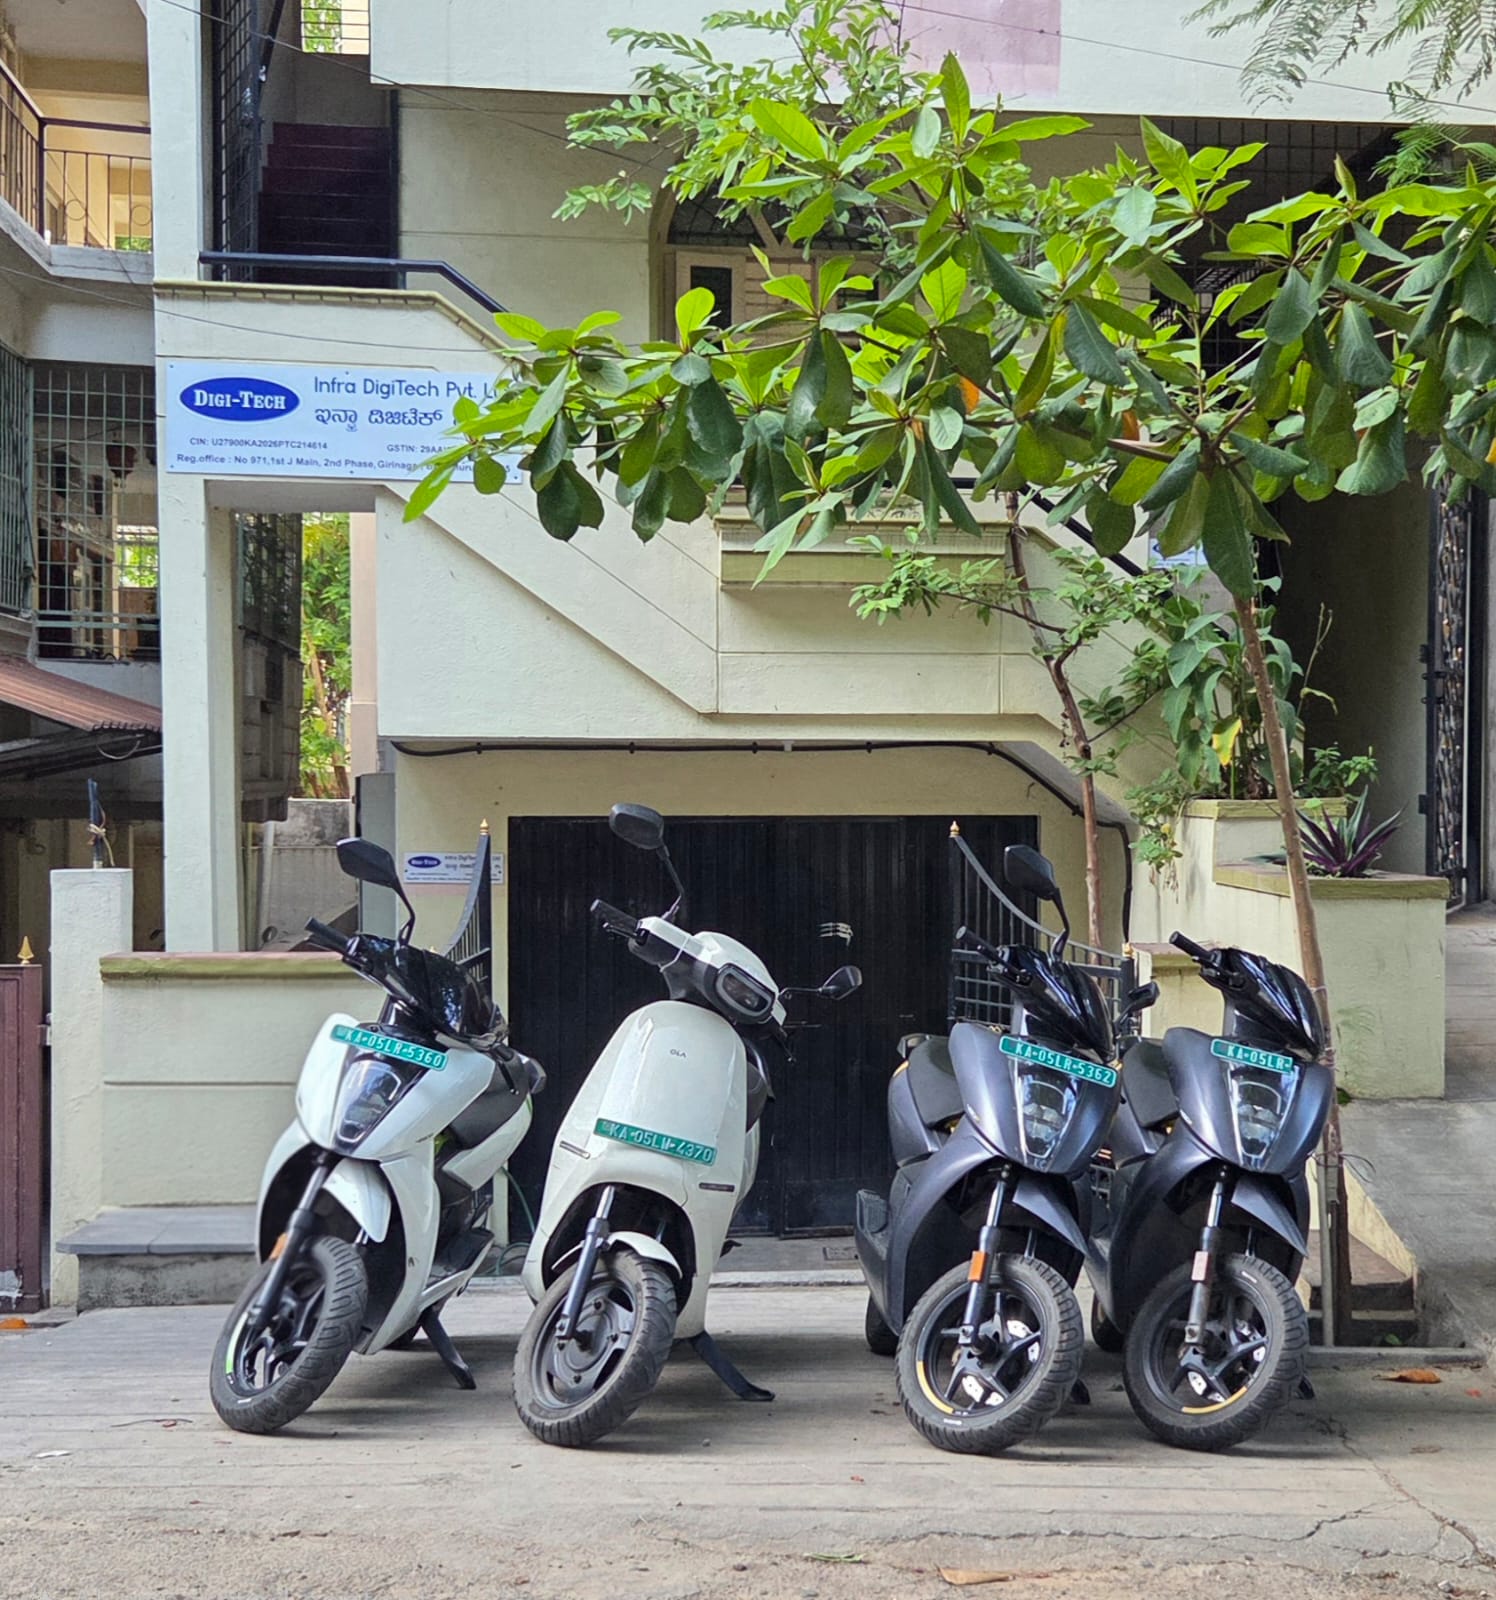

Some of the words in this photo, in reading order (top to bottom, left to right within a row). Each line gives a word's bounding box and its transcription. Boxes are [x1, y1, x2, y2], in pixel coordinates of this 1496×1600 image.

[314, 376, 356, 394] Infra
[363, 378, 439, 400] DigiTech
[446, 381, 477, 398] Pvt.
[189, 437, 208, 446] CIN:
[386, 444, 417, 453] GSTIN:
[234, 456, 248, 464] No
[287, 457, 293, 465] J
[296, 457, 322, 467] Main,
[323, 459, 341, 467] 2nd
[344, 459, 376, 470] Phase,
